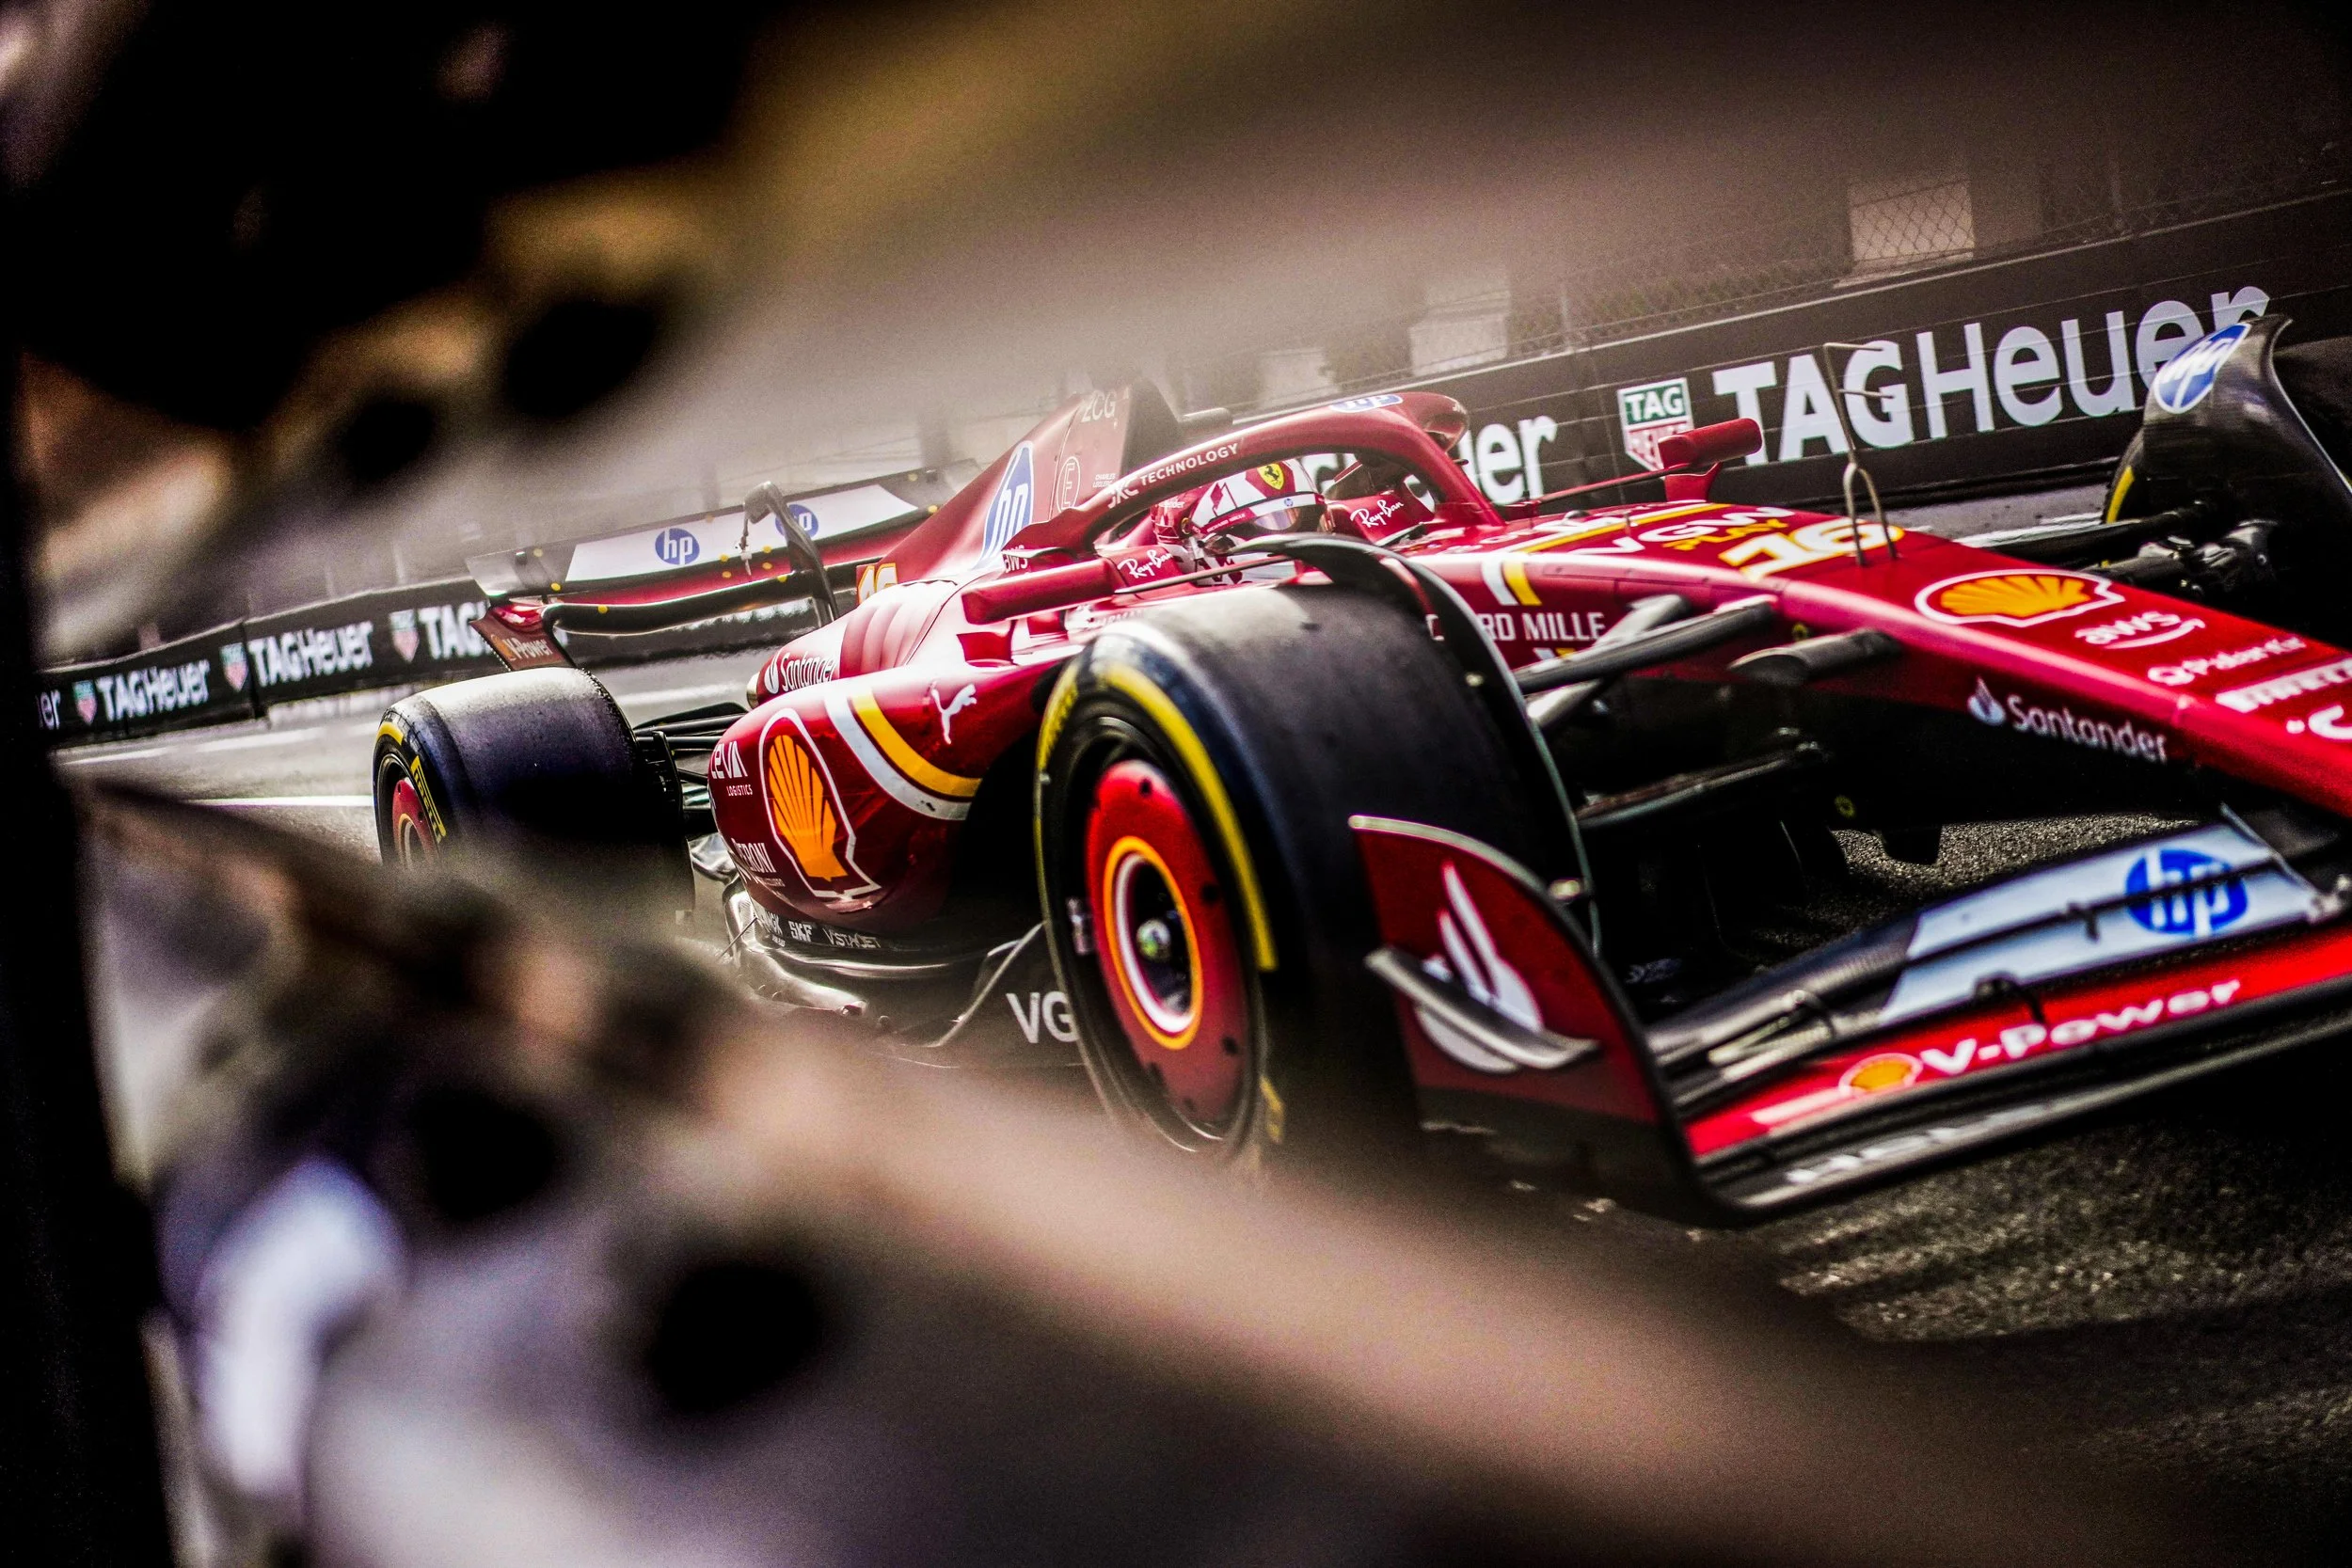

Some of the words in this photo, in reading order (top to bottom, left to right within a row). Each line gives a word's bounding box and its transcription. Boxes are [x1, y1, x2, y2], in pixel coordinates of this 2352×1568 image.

[1625, 386, 1684, 421] TAG
[1140, 442, 1238, 485] TECHNOLOGY
[662, 527, 694, 565] hp
[1718, 517, 1906, 583] 16
[2007, 694, 2168, 765] Santander
[2145, 847, 2231, 939] hp
[788, 920, 812, 942] SKF
[1920, 979, 2241, 1074] V-Power
